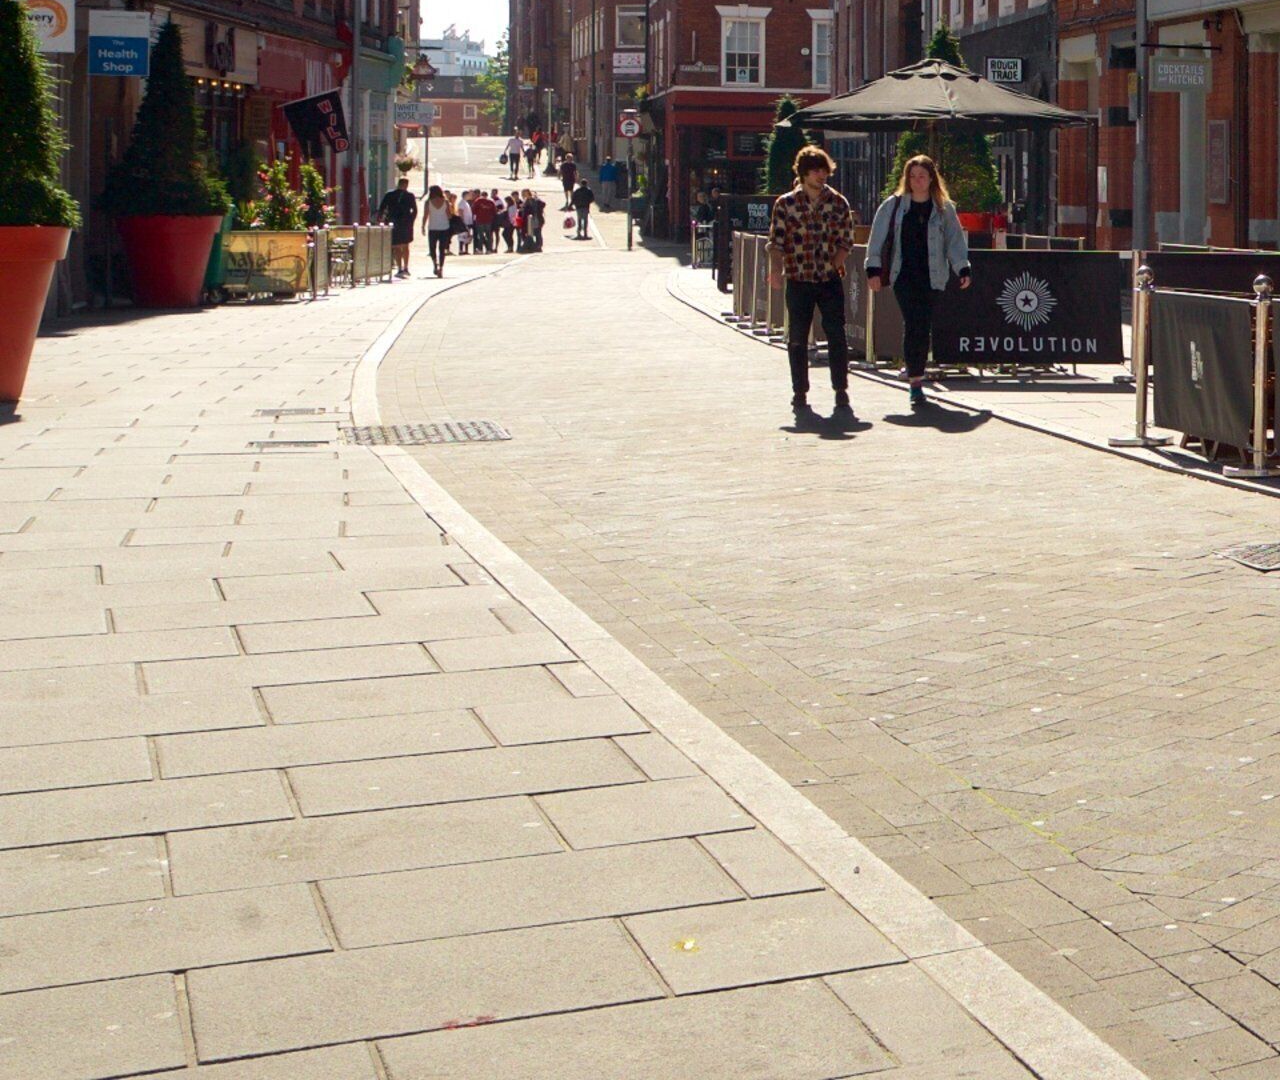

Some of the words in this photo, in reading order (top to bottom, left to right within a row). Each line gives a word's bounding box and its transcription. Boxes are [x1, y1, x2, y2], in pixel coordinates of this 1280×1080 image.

[97, 48, 138, 59] Health
[102, 62, 133, 73] Shop
[990, 60, 1018, 70] ROUGH
[1158, 64, 1204, 75] COCKTAILS
[991, 70, 1019, 80] TRADE
[1169, 74, 1204, 85] KITCHEN
[396, 103, 418, 112] WHITE
[396, 111, 416, 120] ROSE
[316, 99, 349, 153] WILD
